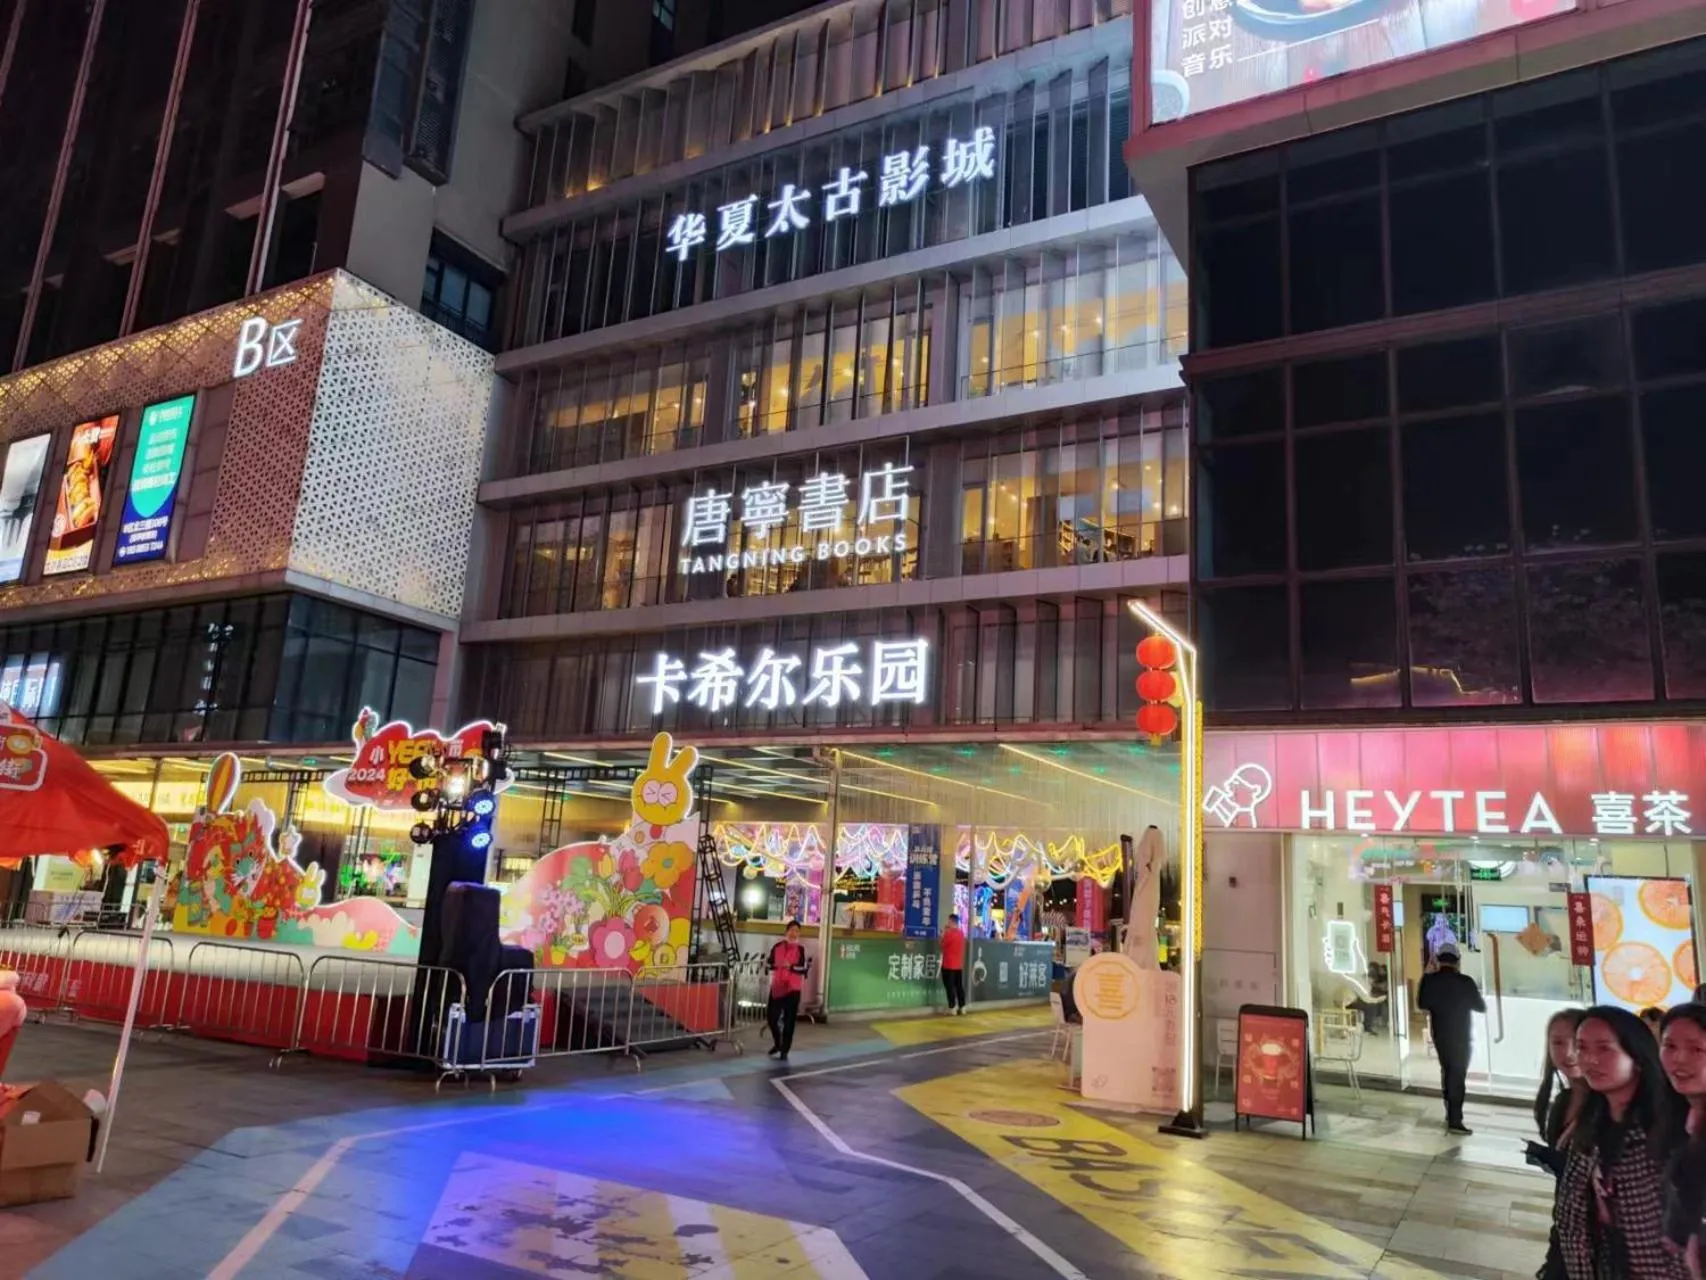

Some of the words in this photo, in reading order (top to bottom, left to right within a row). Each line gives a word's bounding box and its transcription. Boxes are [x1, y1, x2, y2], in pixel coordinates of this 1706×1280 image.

[1182, 14, 1232, 49] 派对
[1181, 43, 1233, 77] 音乐
[666, 126, 997, 262] 华夏太古影城
[233, 317, 303, 377] B区
[681, 462, 915, 547] 唐寧書店
[680, 546, 806, 575] TANGNING
[817, 533, 907, 559] BOOKS
[636, 638, 929, 714] 卡希尔乐园
[349, 768, 385, 781] 2024
[1301, 789, 1563, 834] HEYTEA
[1591, 790, 1693, 836] 喜茶
